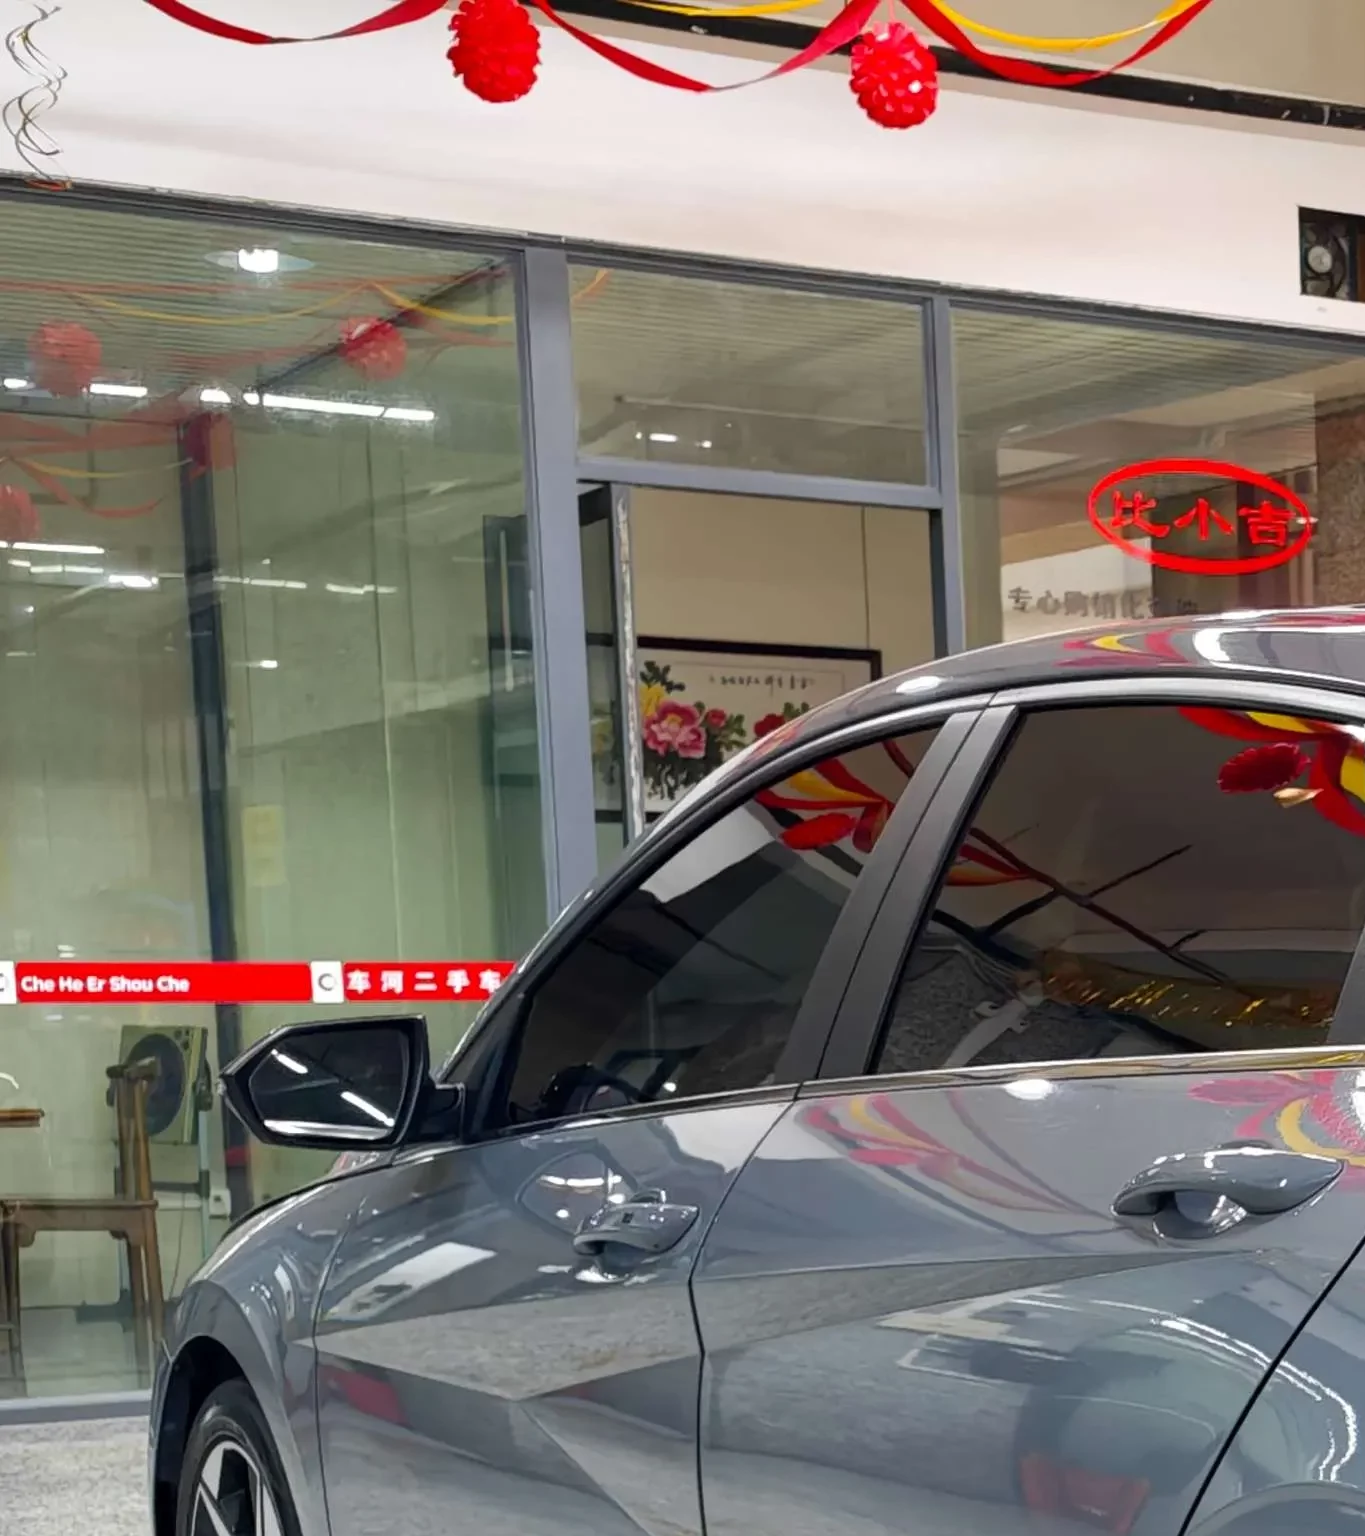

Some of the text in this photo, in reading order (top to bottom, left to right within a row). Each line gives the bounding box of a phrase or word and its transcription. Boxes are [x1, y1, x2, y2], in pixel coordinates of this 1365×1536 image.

[20, 975, 190, 993] Che He Er Shou Che
